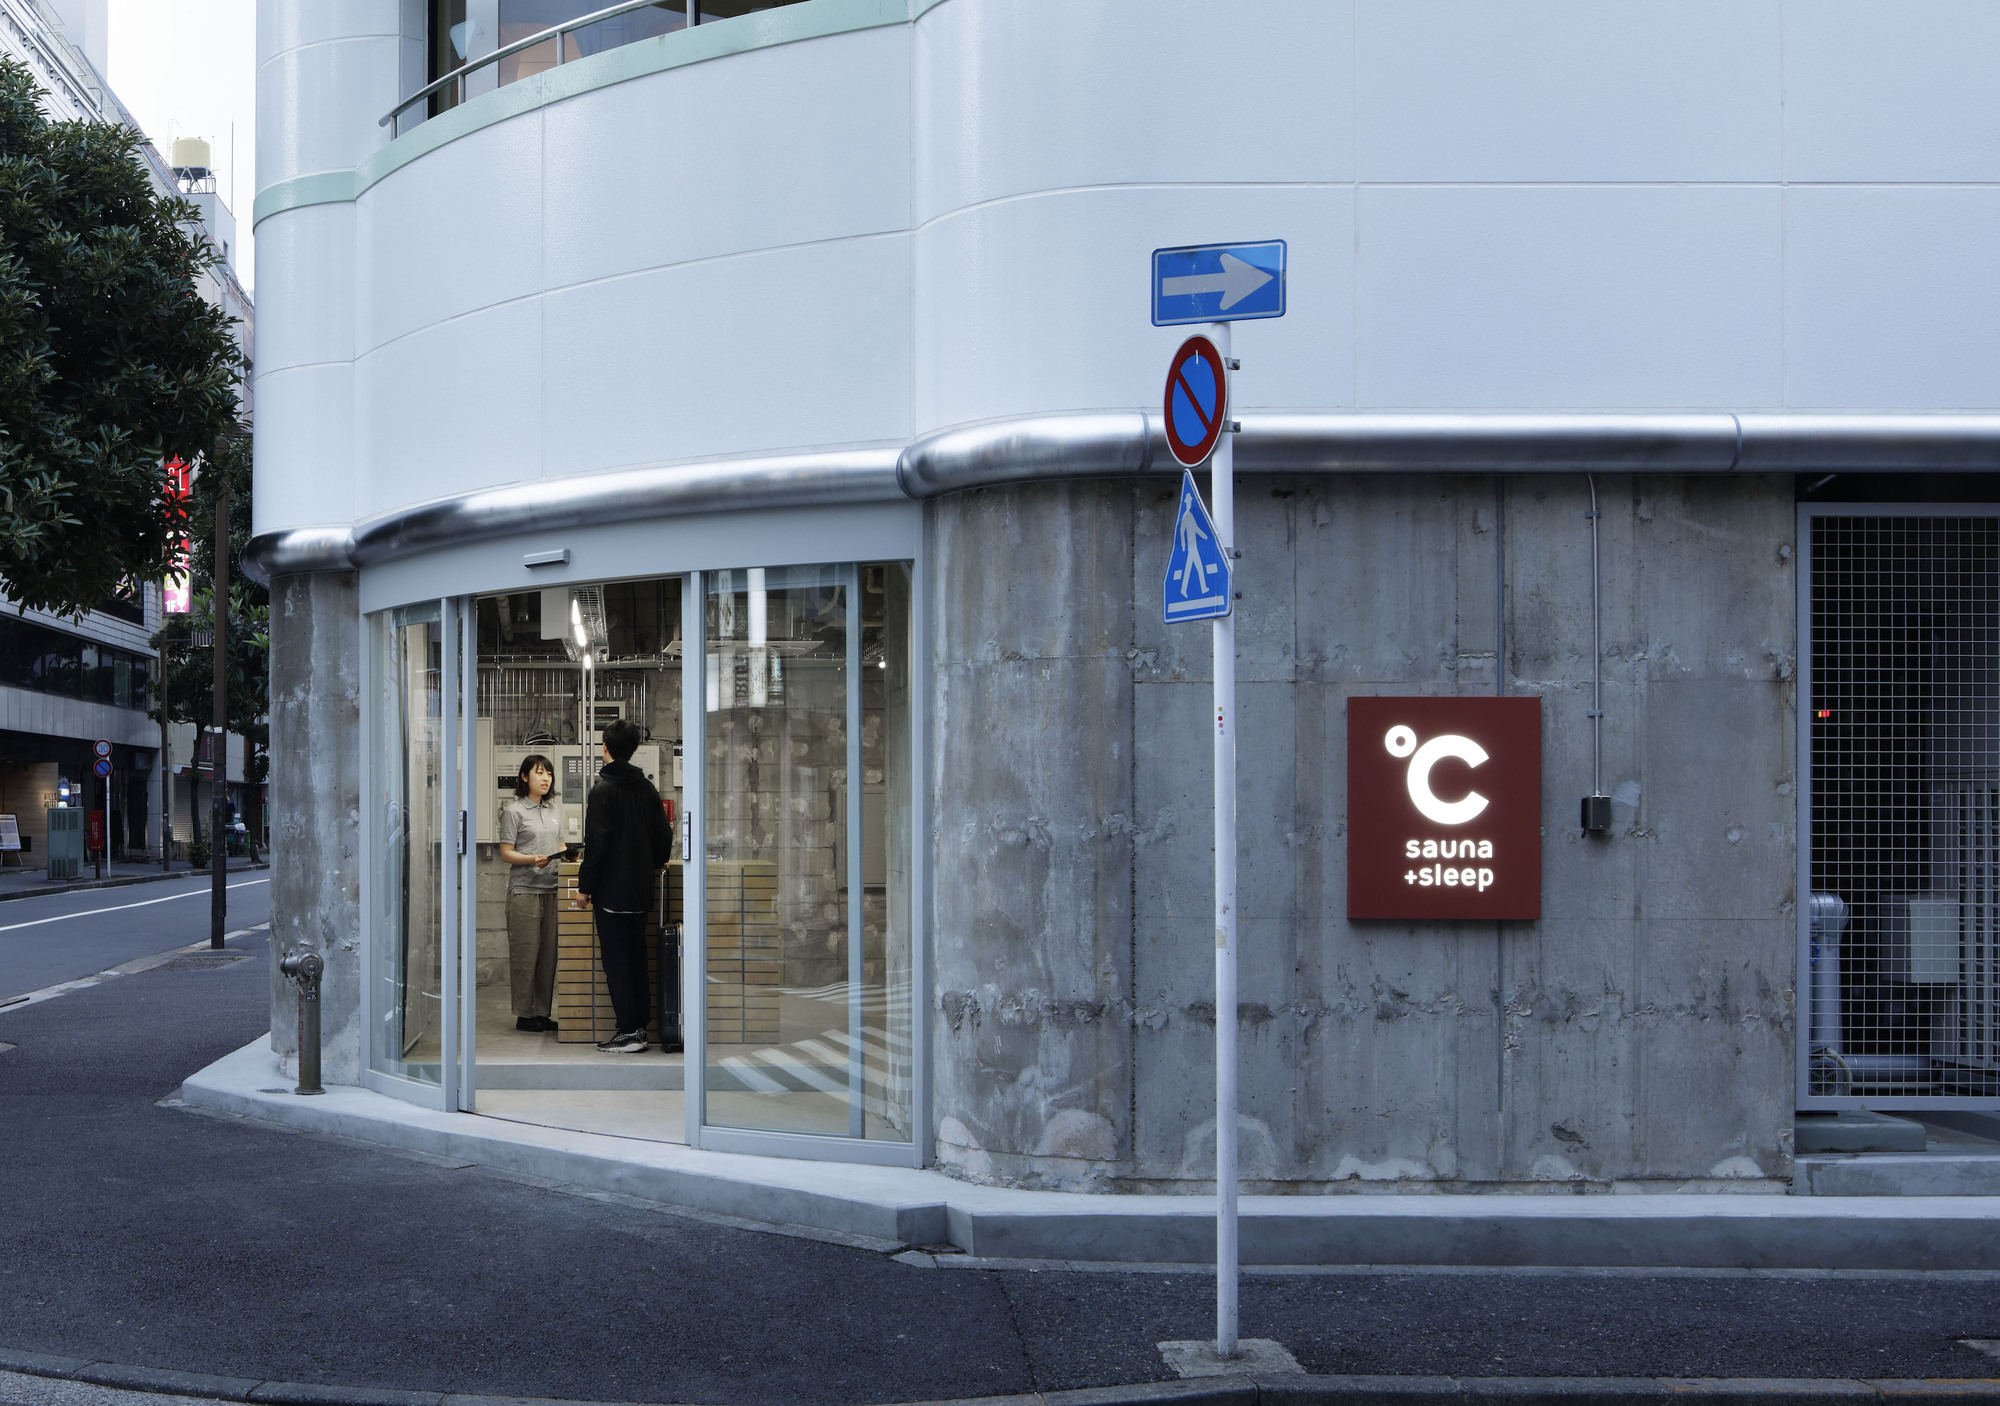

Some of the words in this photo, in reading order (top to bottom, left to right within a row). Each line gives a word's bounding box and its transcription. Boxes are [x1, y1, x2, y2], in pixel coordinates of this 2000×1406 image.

[165, 600, 177, 613] 1F
[98, 743, 109, 753] 30
[1405, 839, 1493, 859] sauna
[1404, 864, 1494, 892] +sleep
